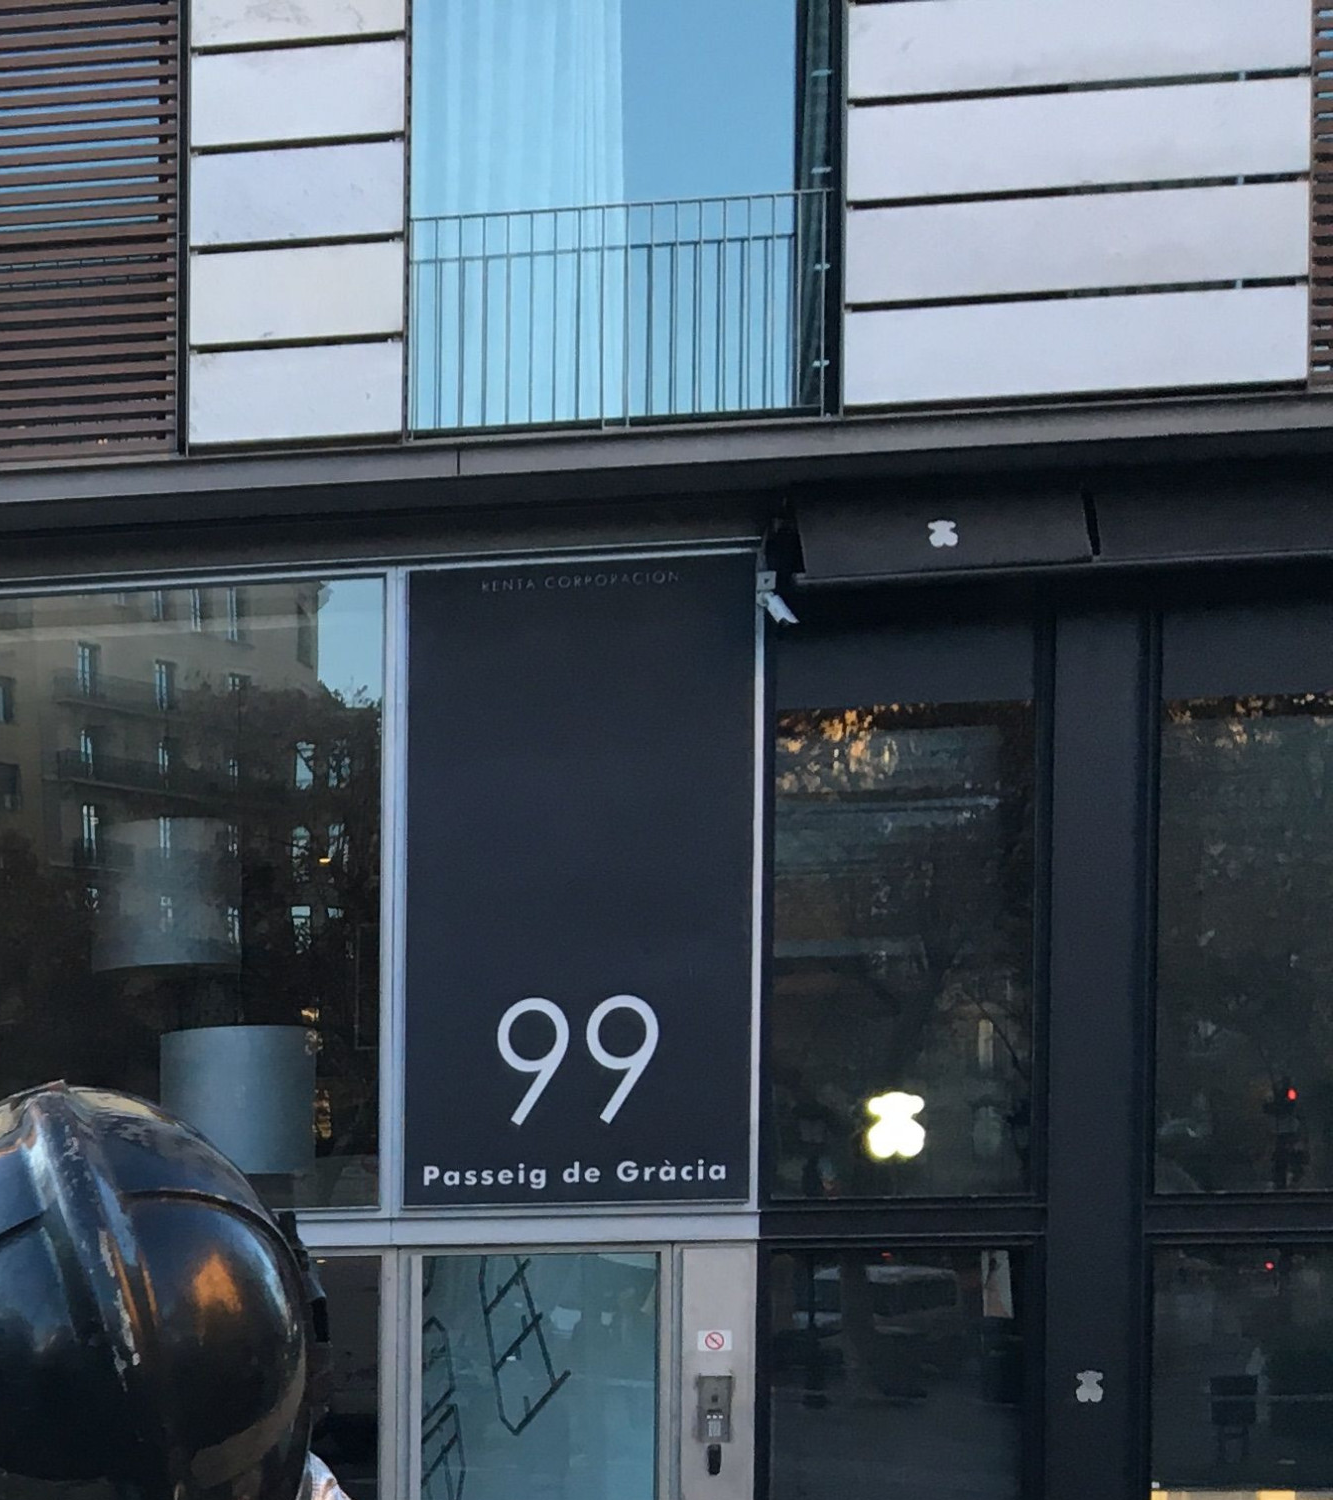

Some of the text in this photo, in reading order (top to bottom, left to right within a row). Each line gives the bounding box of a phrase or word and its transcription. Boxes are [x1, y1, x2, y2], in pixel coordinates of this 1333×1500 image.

[482, 578, 535, 592] RENTA
[497, 994, 659, 1126] 99
[423, 1159, 727, 1189] Passeig de Gràcia
